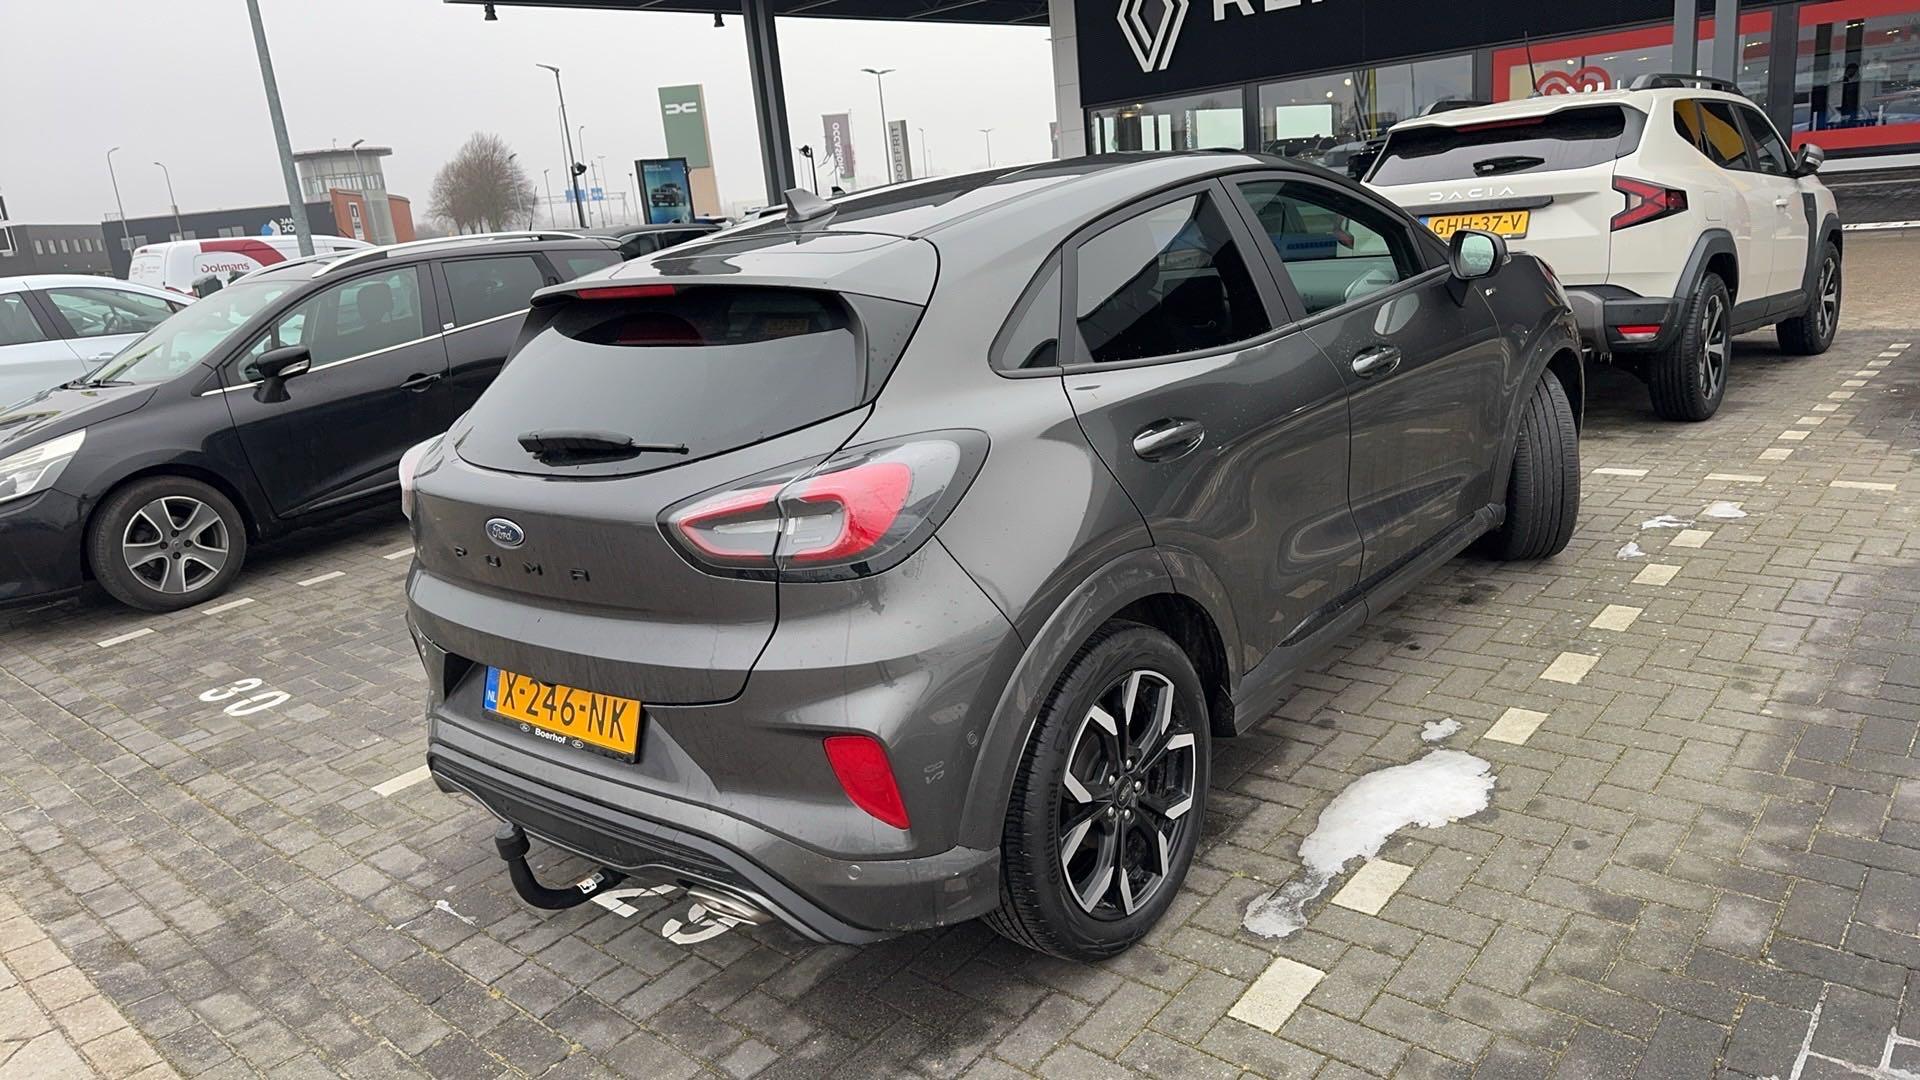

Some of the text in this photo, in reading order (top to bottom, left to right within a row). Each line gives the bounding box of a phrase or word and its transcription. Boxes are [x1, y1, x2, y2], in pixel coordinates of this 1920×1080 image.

[891, 126, 904, 181] ROEFRIT
[1428, 186, 1515, 202] DACIA
[1433, 214, 1523, 235] GHH-37-V
[454, 545, 591, 582] PUMA
[198, 677, 292, 717] 30
[487, 689, 497, 703] NL
[502, 671, 628, 743] X-246-NK
[534, 727, 567, 744] Boerhof
